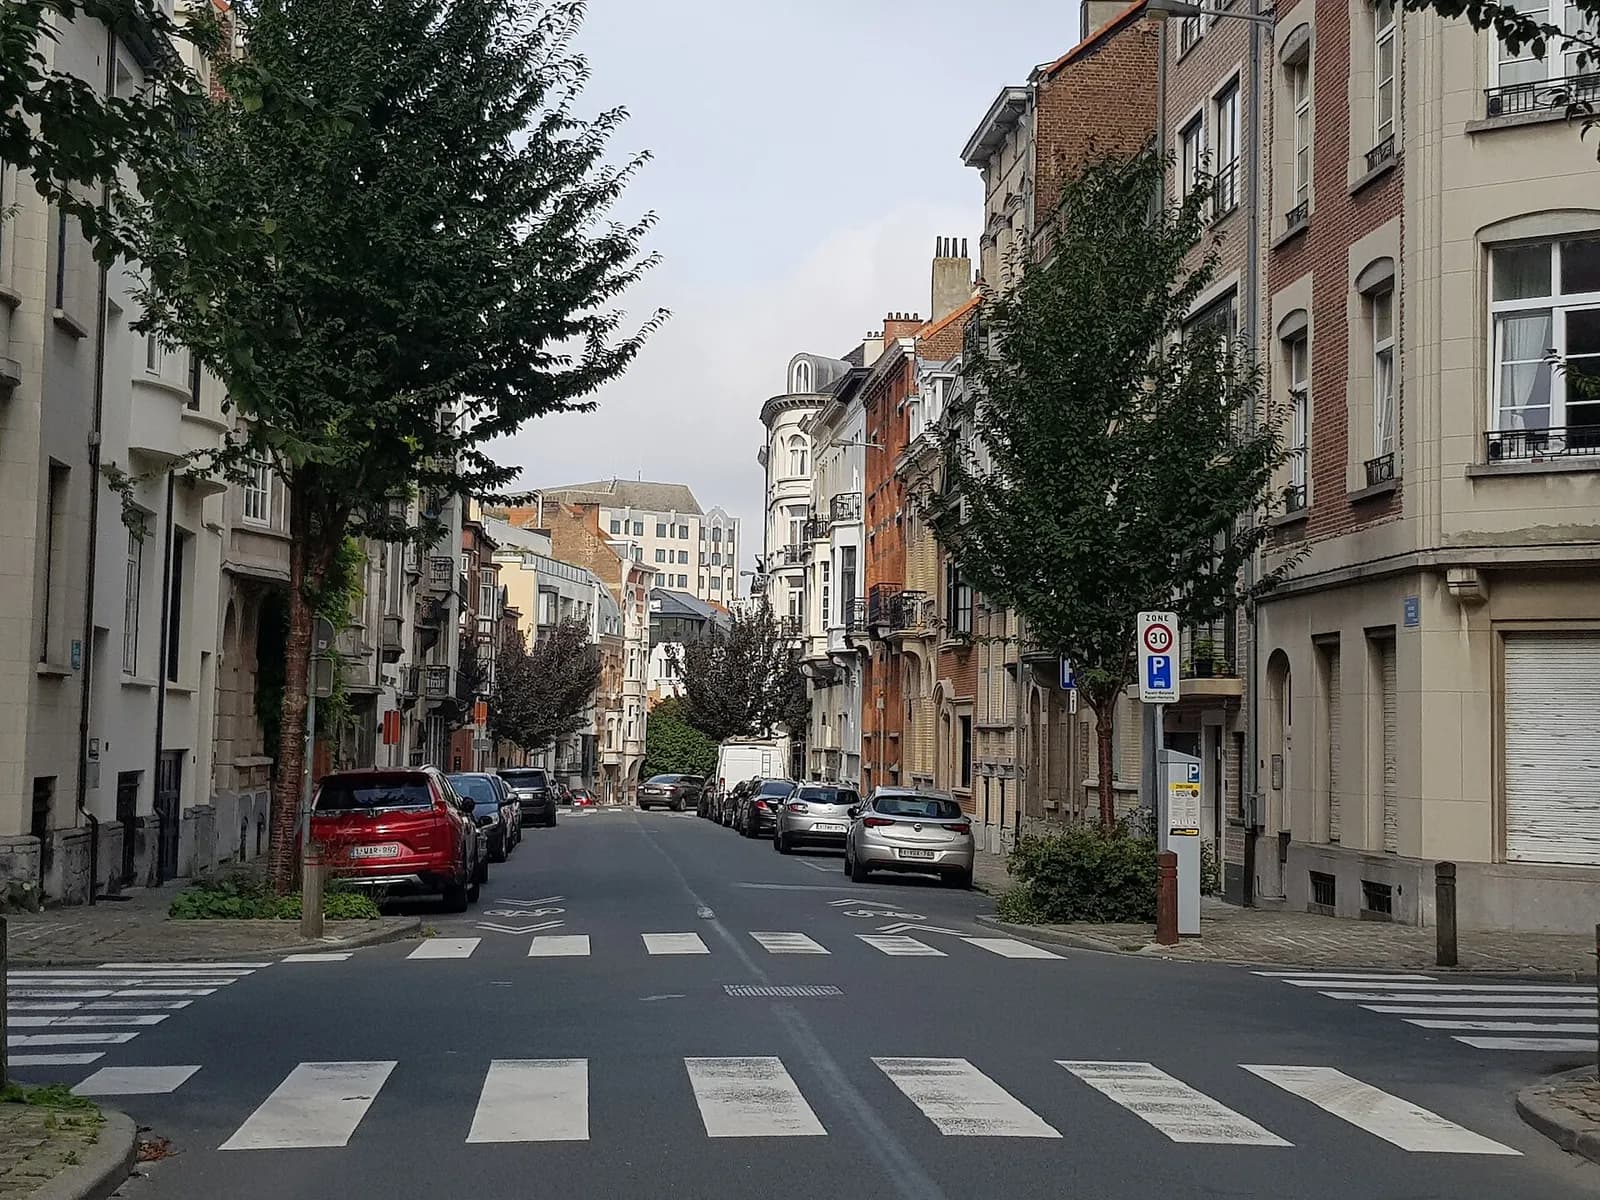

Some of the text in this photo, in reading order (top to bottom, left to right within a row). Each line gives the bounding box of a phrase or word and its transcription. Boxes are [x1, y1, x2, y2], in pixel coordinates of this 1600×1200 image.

[1145, 614, 1169, 622] ZONE
[1150, 632, 1167, 644] 30
[1152, 656, 1165, 675] P
[1188, 764, 1199, 779] P
